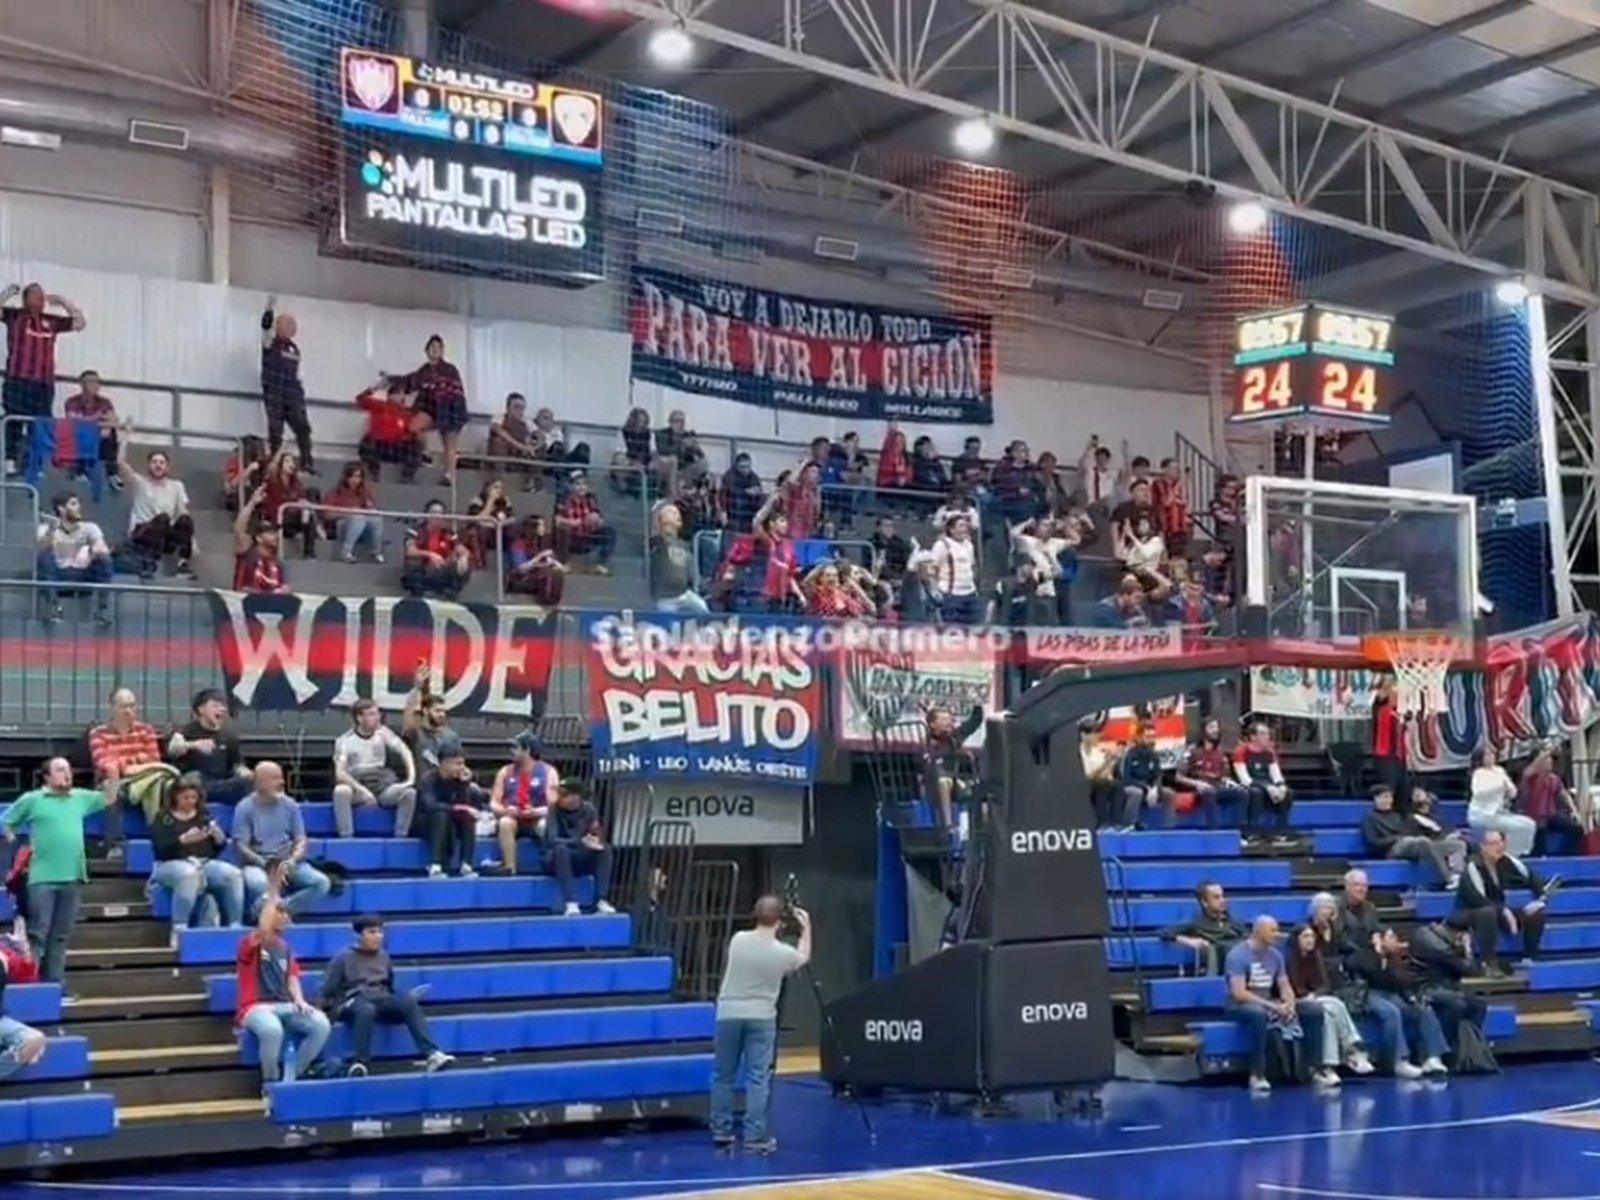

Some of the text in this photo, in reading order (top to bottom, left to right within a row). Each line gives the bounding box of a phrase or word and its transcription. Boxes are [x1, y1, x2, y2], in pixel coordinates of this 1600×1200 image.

[396, 153, 586, 221] MULTILED
[366, 192, 586, 248] PANTALLAS LED
[640, 279, 733, 371] PARA
[749, 327, 813, 388] VER
[826, 345, 868, 392] AL
[701, 284, 931, 342] VOY A DEJARLO TODO
[1243, 361, 1292, 412] 24
[1322, 362, 1377, 412] 24
[213, 588, 553, 717] WILDE
[599, 614, 812, 690] GRACIAS
[602, 688, 810, 750] BELITO
[666, 794, 754, 817] enova
[1011, 828, 1092, 853] enova
[864, 1019, 924, 1042] enova
[1021, 1001, 1088, 1023] enova
